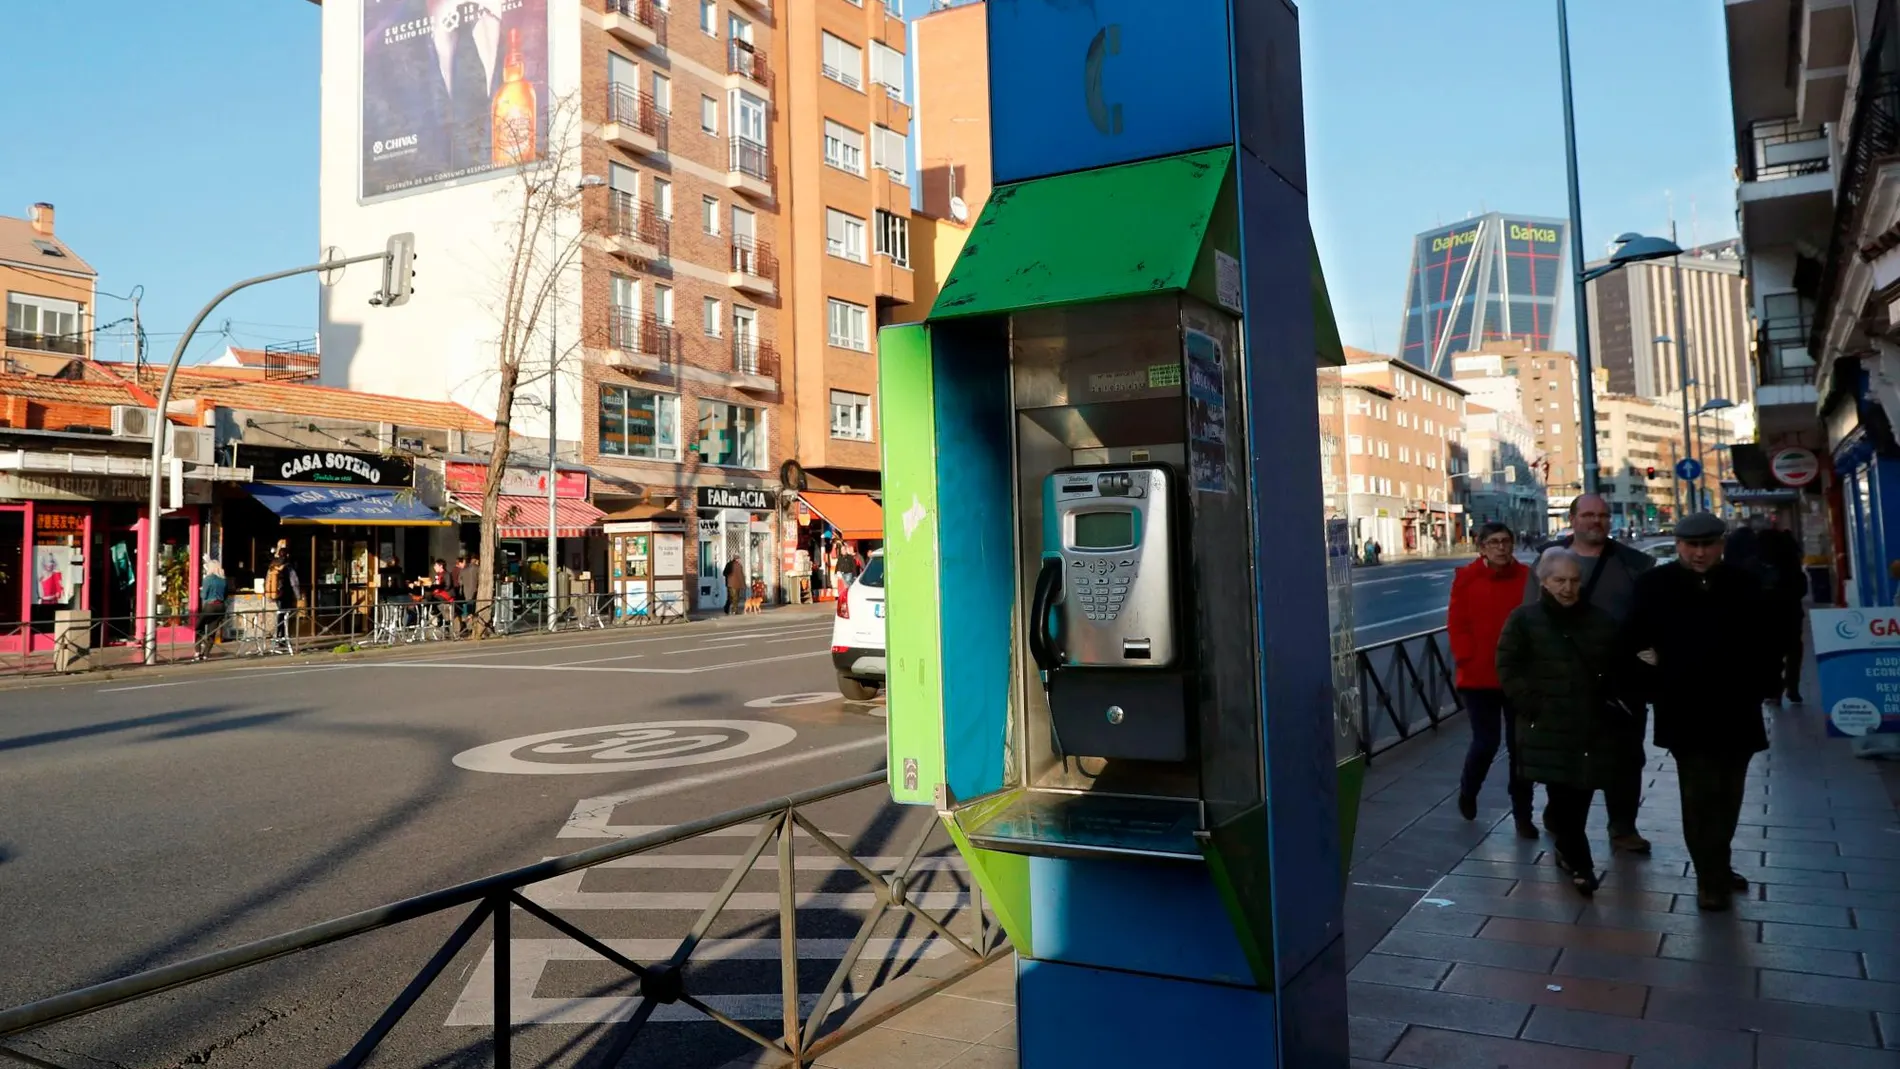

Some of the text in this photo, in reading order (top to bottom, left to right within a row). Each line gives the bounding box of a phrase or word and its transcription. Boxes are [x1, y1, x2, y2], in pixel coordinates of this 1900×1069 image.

[385, 134, 418, 151] CHIVAS
[1432, 230, 1477, 252] Bankia
[1510, 224, 1556, 242] Bankia
[281, 453, 322, 478] CASA
[325, 452, 381, 484] SOTERO
[59, 477, 100, 496] BELLEZA
[290, 489, 393, 507] CASA SOTERO
[1875, 657, 1900, 667] AUD
[1876, 683, 1900, 693] REV
